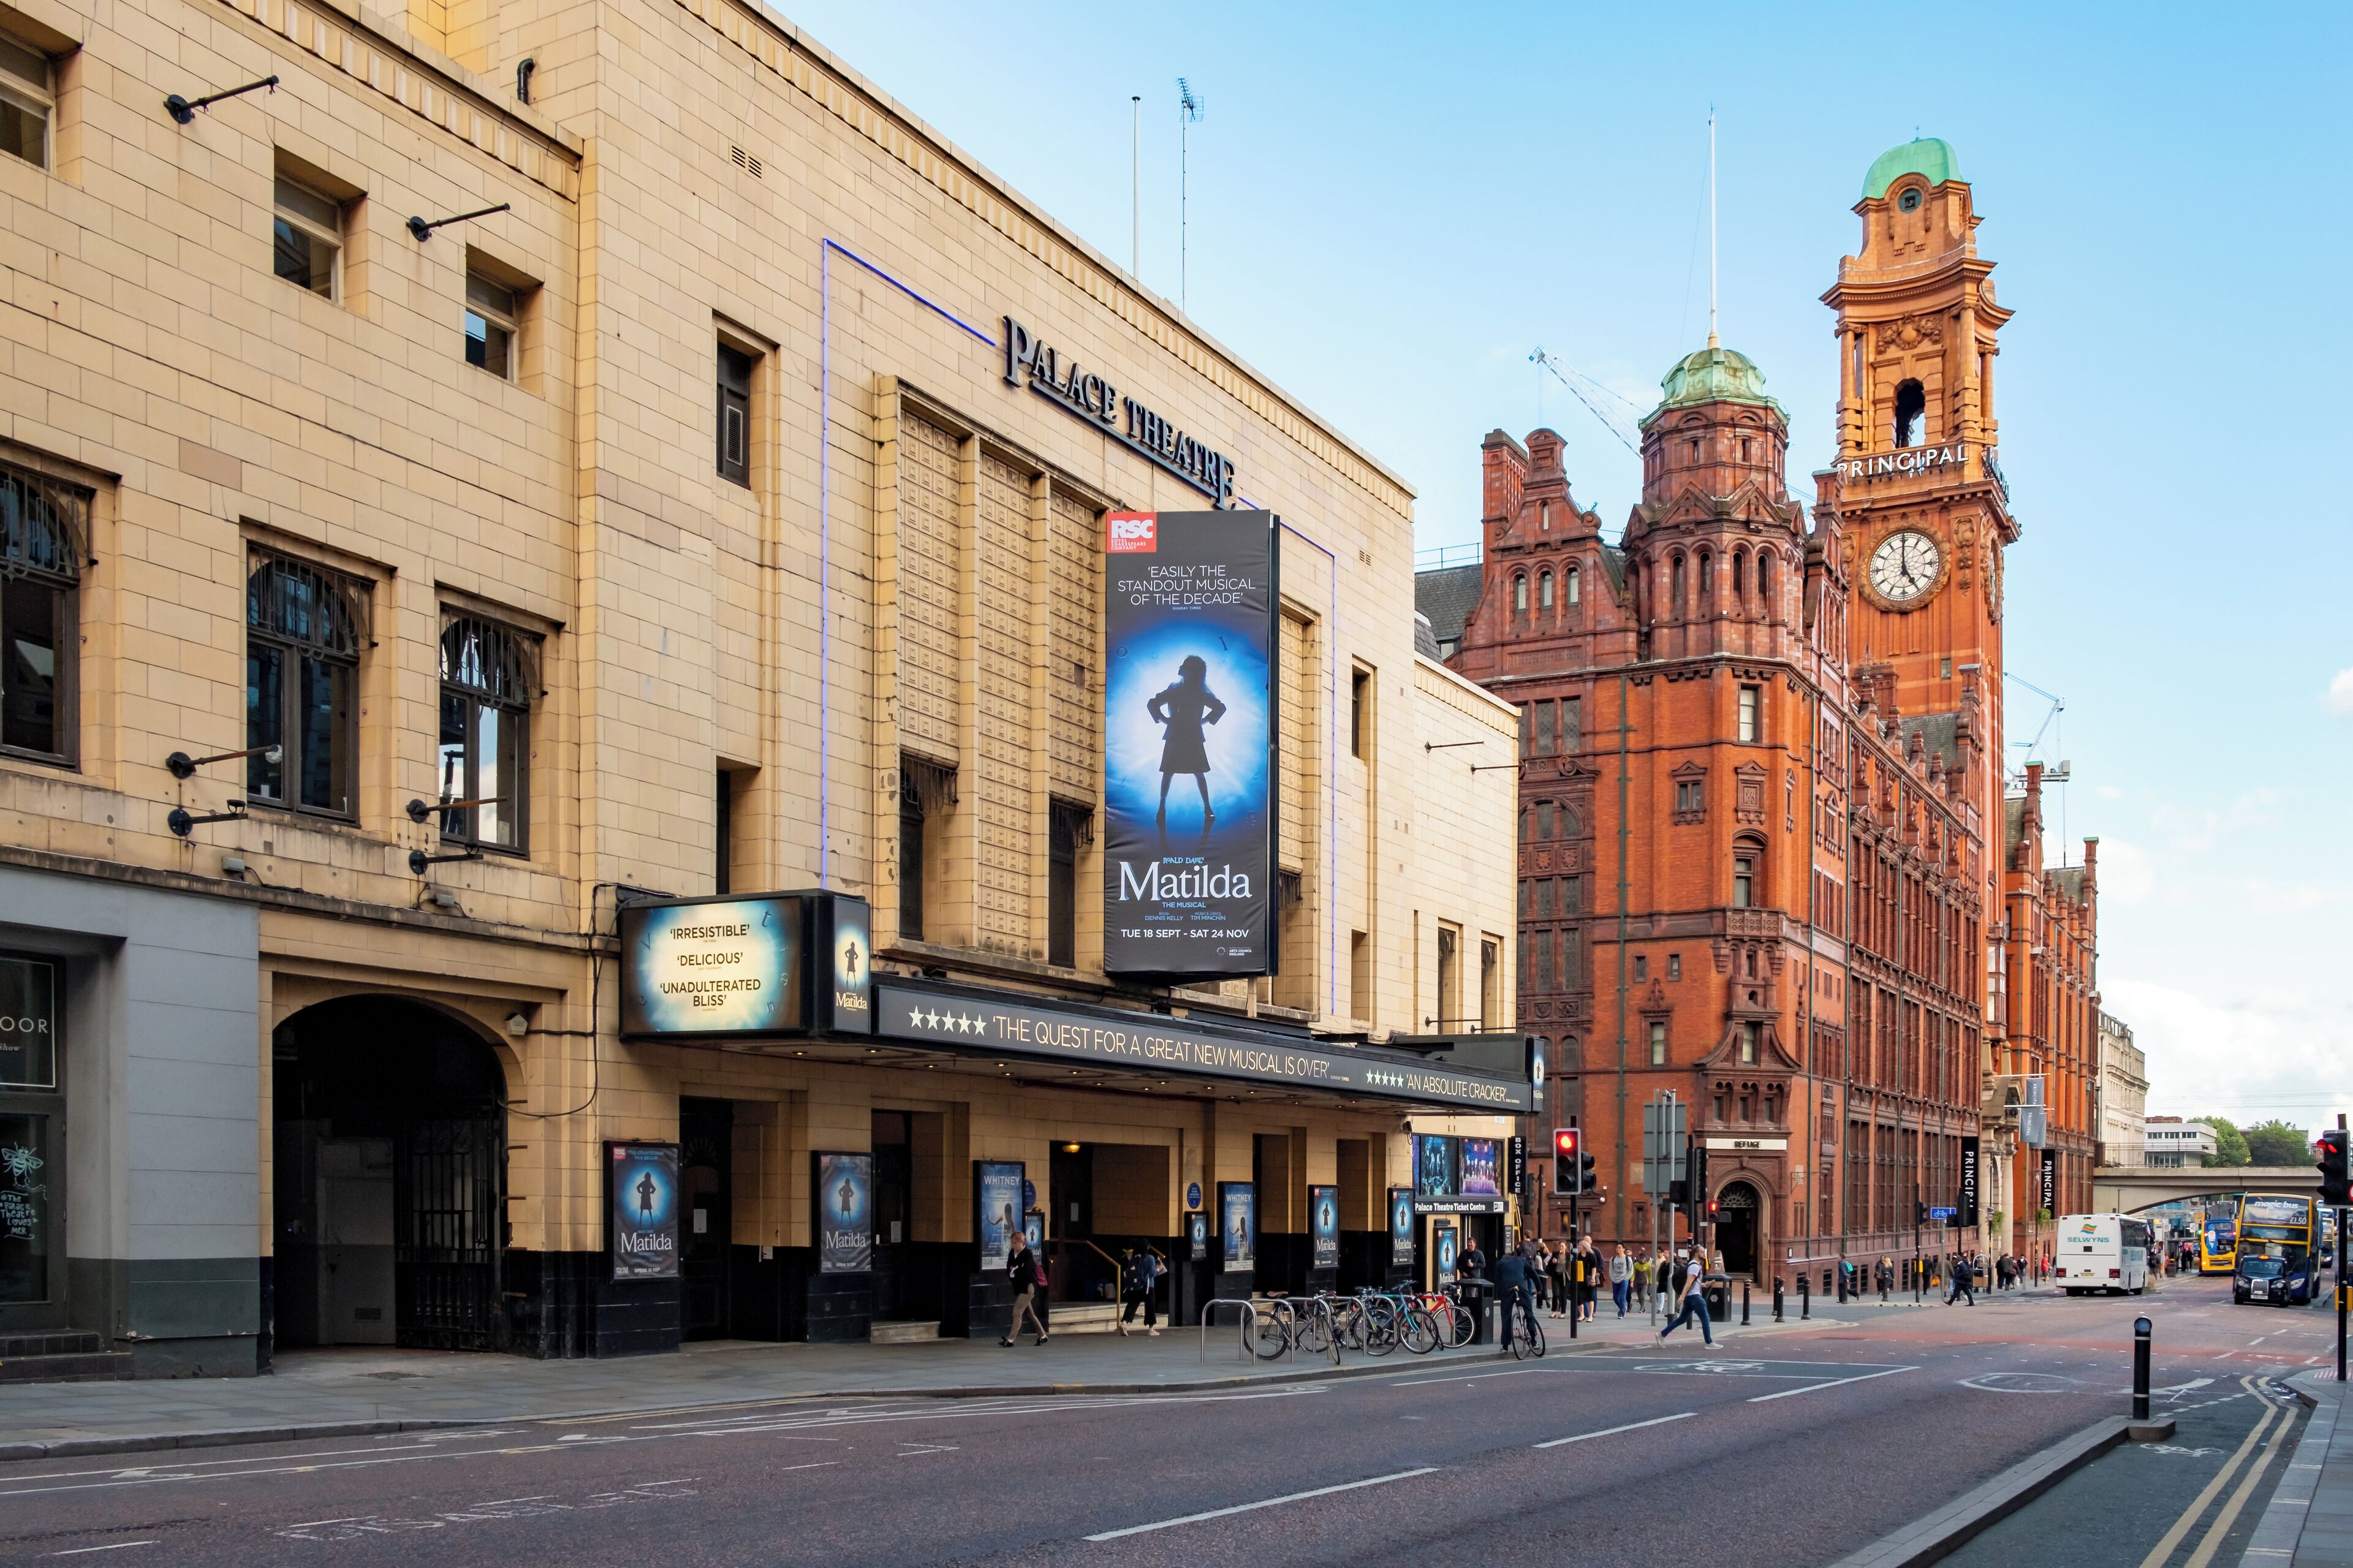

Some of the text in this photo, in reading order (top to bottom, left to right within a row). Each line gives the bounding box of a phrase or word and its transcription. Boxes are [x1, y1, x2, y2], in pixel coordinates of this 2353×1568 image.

[1002, 315, 1236, 511] PALACE THEATRE
[1112, 520, 1153, 539] RSC
[1199, 565, 1226, 577] THE
[1118, 578, 1256, 592] STANDOUT MUSICAL
[1131, 594, 1150, 605] OF
[1153, 593, 1180, 605] THE
[1118, 862, 1253, 901] Matilda
[1121, 930, 1141, 938] TUE
[1227, 929, 1249, 937] NOV
[836, 992, 868, 1009] Matilda
[1036, 1021, 1089, 1049] QUEST
[1094, 1029, 1126, 1054] FOR
[1130, 1035, 1141, 1056] A
[1145, 1037, 1191, 1061] GREAT
[1195, 1043, 1227, 1066] NEW
[1229, 1048, 1282, 1074] MUSICAL
[1285, 1056, 1294, 1075] IS
[1423, 1076, 1468, 1097] ABSOLUTE
[984, 1175, 1020, 1186] WHITNEY
[1226, 1194, 1251, 1202] WHITNEY
[1415, 1203, 1433, 1211] Palace
[2255, 1200, 2281, 1210] magic
[621, 1232, 673, 1253] Matilda
[826, 1231, 866, 1249] Matilda
[1317, 1239, 1336, 1252] Matilda
[1395, 1238, 1412, 1250] Matilda
[1440, 1273, 1455, 1284] Matilda
